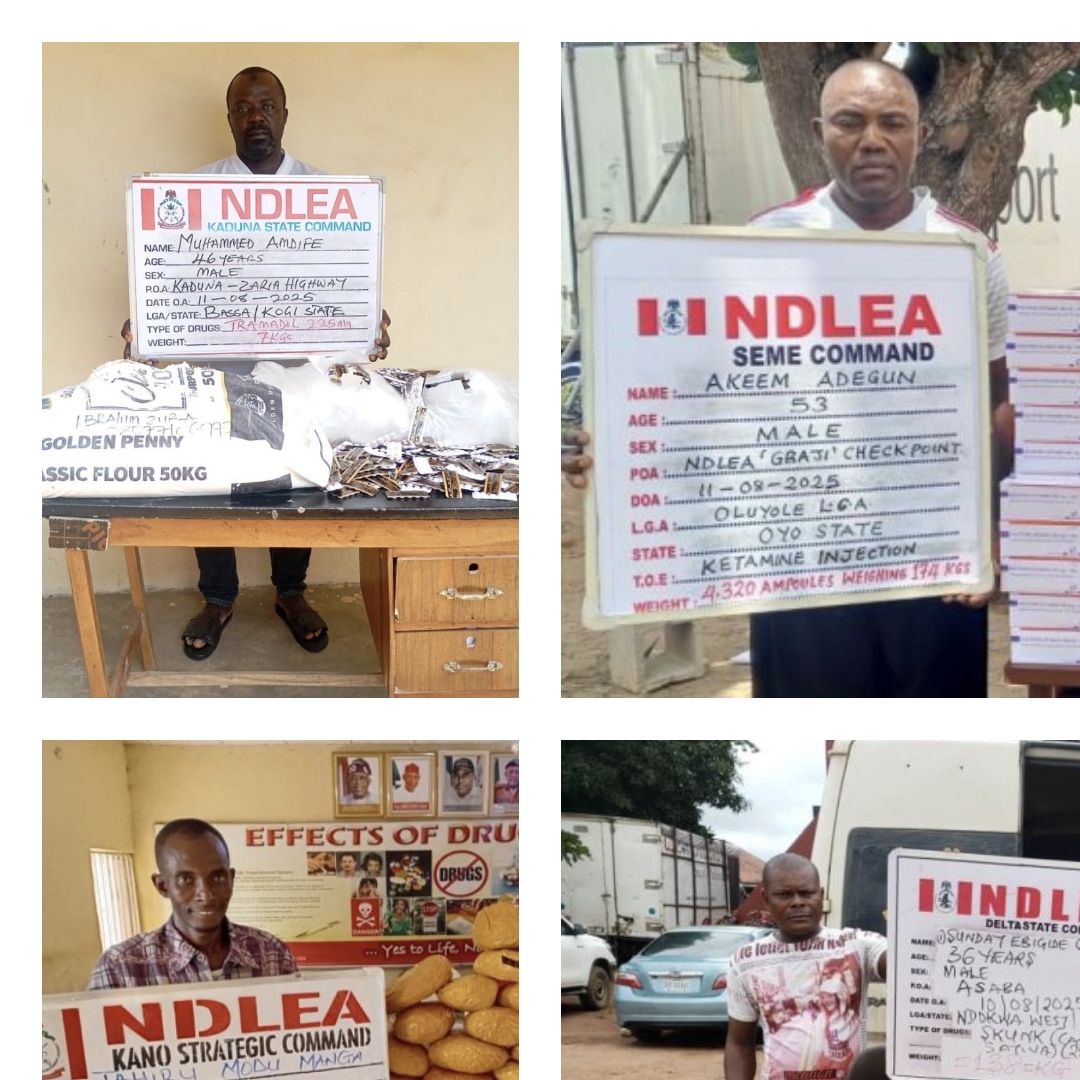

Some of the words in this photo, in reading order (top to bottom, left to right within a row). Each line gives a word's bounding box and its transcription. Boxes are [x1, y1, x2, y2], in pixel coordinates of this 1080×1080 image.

[221, 188, 358, 220] NDLEA
[207, 221, 261, 232] KADUNA
[265, 222, 302, 232] STATE
[305, 221, 371, 232] COMMAND
[144, 244, 176, 253] NAME:
[177, 233, 255, 253] MUHAMMED
[144, 257, 166, 266] AGE:
[192, 255, 215, 264] 46
[144, 271, 166, 280] SEX:
[196, 267, 243, 278] MALE
[173, 279, 223, 293] KADUNA
[284, 278, 347, 291] HIGHWAY
[146, 310, 201, 320] LGA/STATE:
[725, 294, 942, 340] NDLEA
[146, 325, 169, 334] TYPE
[170, 325, 186, 334] OF
[187, 324, 222, 333] DRUGS:
[147, 338, 187, 347] WEIGHT:
[732, 345, 802, 367] SEME
[809, 342, 935, 365] COMMAND
[705, 373, 791, 393] AKEEM
[816, 370, 916, 389] ADEGUN
[790, 397, 828, 414] 53
[756, 424, 842, 442] MALE
[41, 434, 116, 451] GOLDEN
[120, 435, 184, 449] PENNY
[684, 455, 756, 473] NDLEA
[92, 466, 156, 482] FLOUR
[159, 466, 208, 481] 50KG
[714, 503, 805, 522] OLUYOLE
[759, 526, 802, 545] OYO
[816, 521, 884, 539] STATE
[701, 551, 805, 576] KETAMINE
[818, 542, 916, 564] INJECTION
[760, 575, 834, 594] AMPOULES
[841, 567, 907, 586] WEIGHING
[943, 562, 972, 577] KGS
[246, 826, 384, 847] EFFECTS
[392, 825, 439, 846] OF
[439, 866, 483, 882] DRUGS
[381, 944, 406, 959] Yes
[410, 945, 424, 954] to
[946, 945, 975, 965] 36
[980, 950, 1036, 967] YEARS
[943, 966, 989, 979] MALE
[957, 981, 1026, 996] ASABA
[102, 989, 371, 1045] NDLEA
[112, 1047, 171, 1072] KANO
[179, 1033, 278, 1065] STRATEGIC
[282, 1027, 372, 1054] COMMAND
[299, 1051, 363, 1070] MANGA
